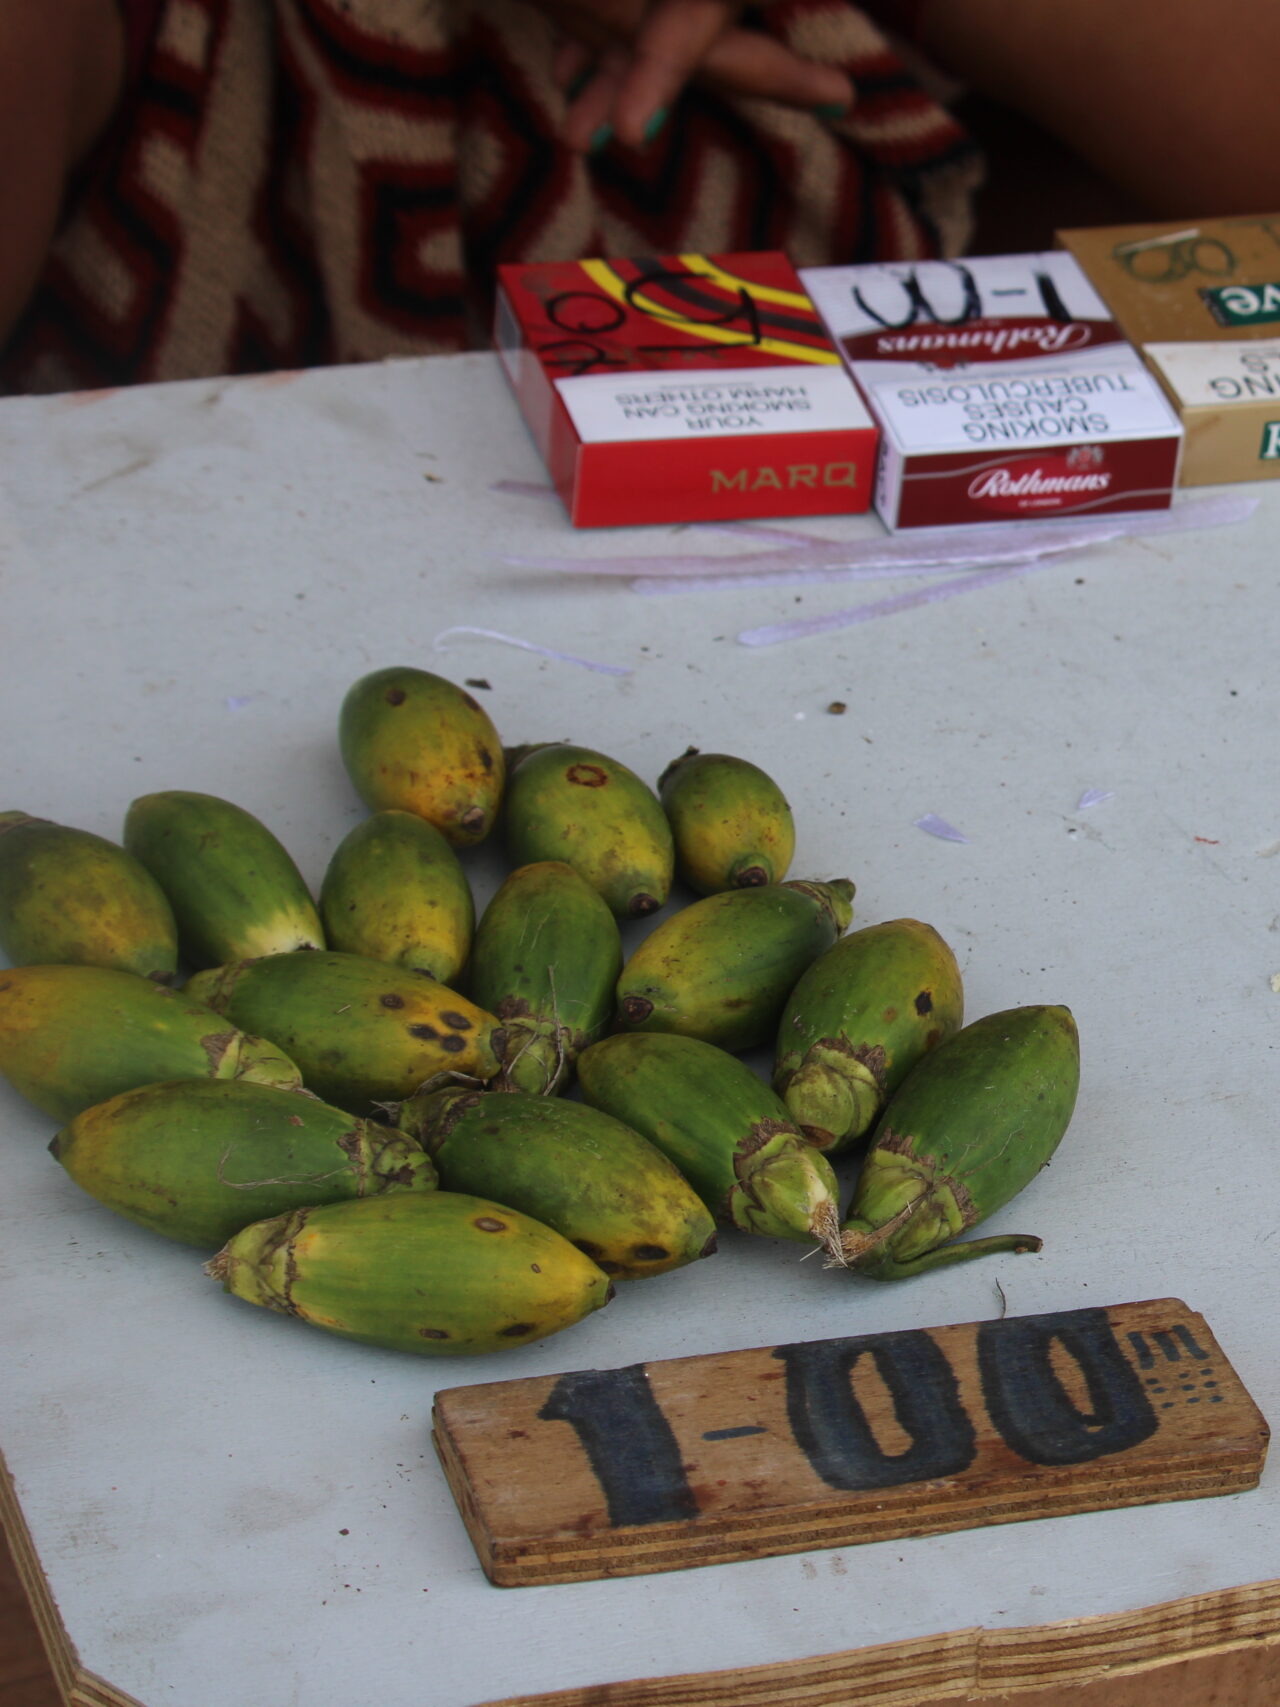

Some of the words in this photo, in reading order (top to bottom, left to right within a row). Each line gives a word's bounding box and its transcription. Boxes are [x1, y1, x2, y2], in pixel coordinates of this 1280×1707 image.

[877, 323, 1090, 355] Rothmans
[615, 387, 724, 406] OTHERS
[728, 385, 807, 401] HARM
[897, 374, 1135, 407] TUBERCULOSIS
[623, 403, 681, 419] CAN
[686, 399, 812, 417] SMOKING
[963, 396, 1088, 421] CAUSES
[686, 416, 763, 430] YOUR
[963, 412, 1109, 443] SMOKING
[710, 462, 857, 493] MARQ
[967, 468, 1112, 499] Rothmans
